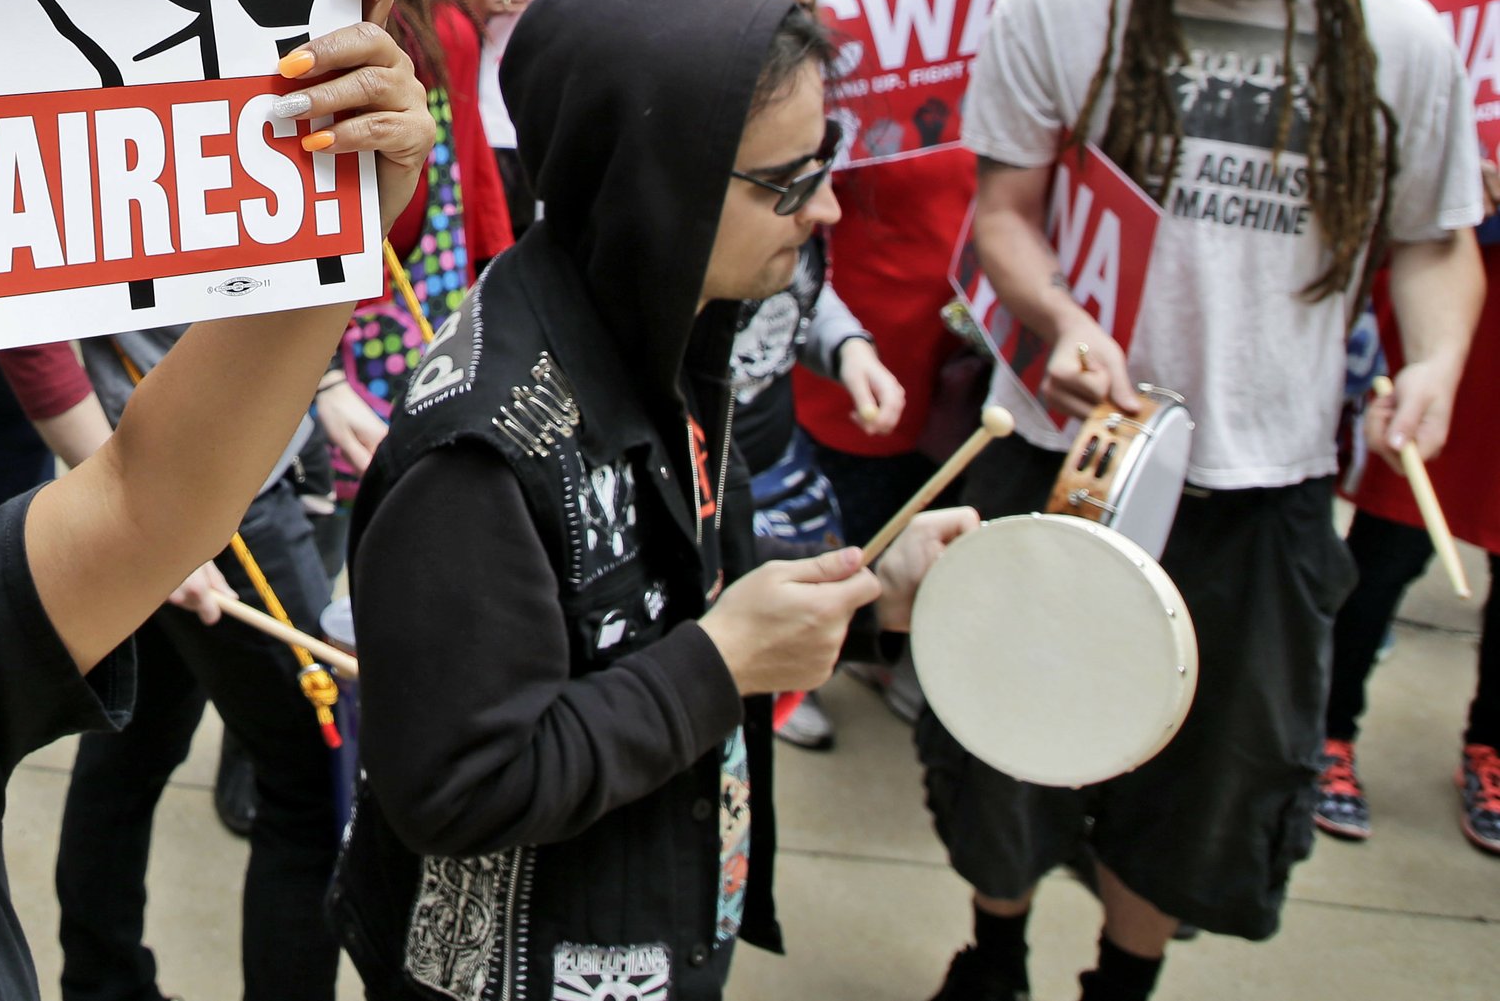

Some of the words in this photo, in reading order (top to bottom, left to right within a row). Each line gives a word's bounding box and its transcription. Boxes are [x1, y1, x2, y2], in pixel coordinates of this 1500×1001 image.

[871, 73, 907, 94] UP.
[908, 61, 966, 88] FIGHT
[1197, 154, 1309, 197] AGAINS
[1173, 186, 1310, 234] MACHINE
[1048, 163, 1121, 338] WA
